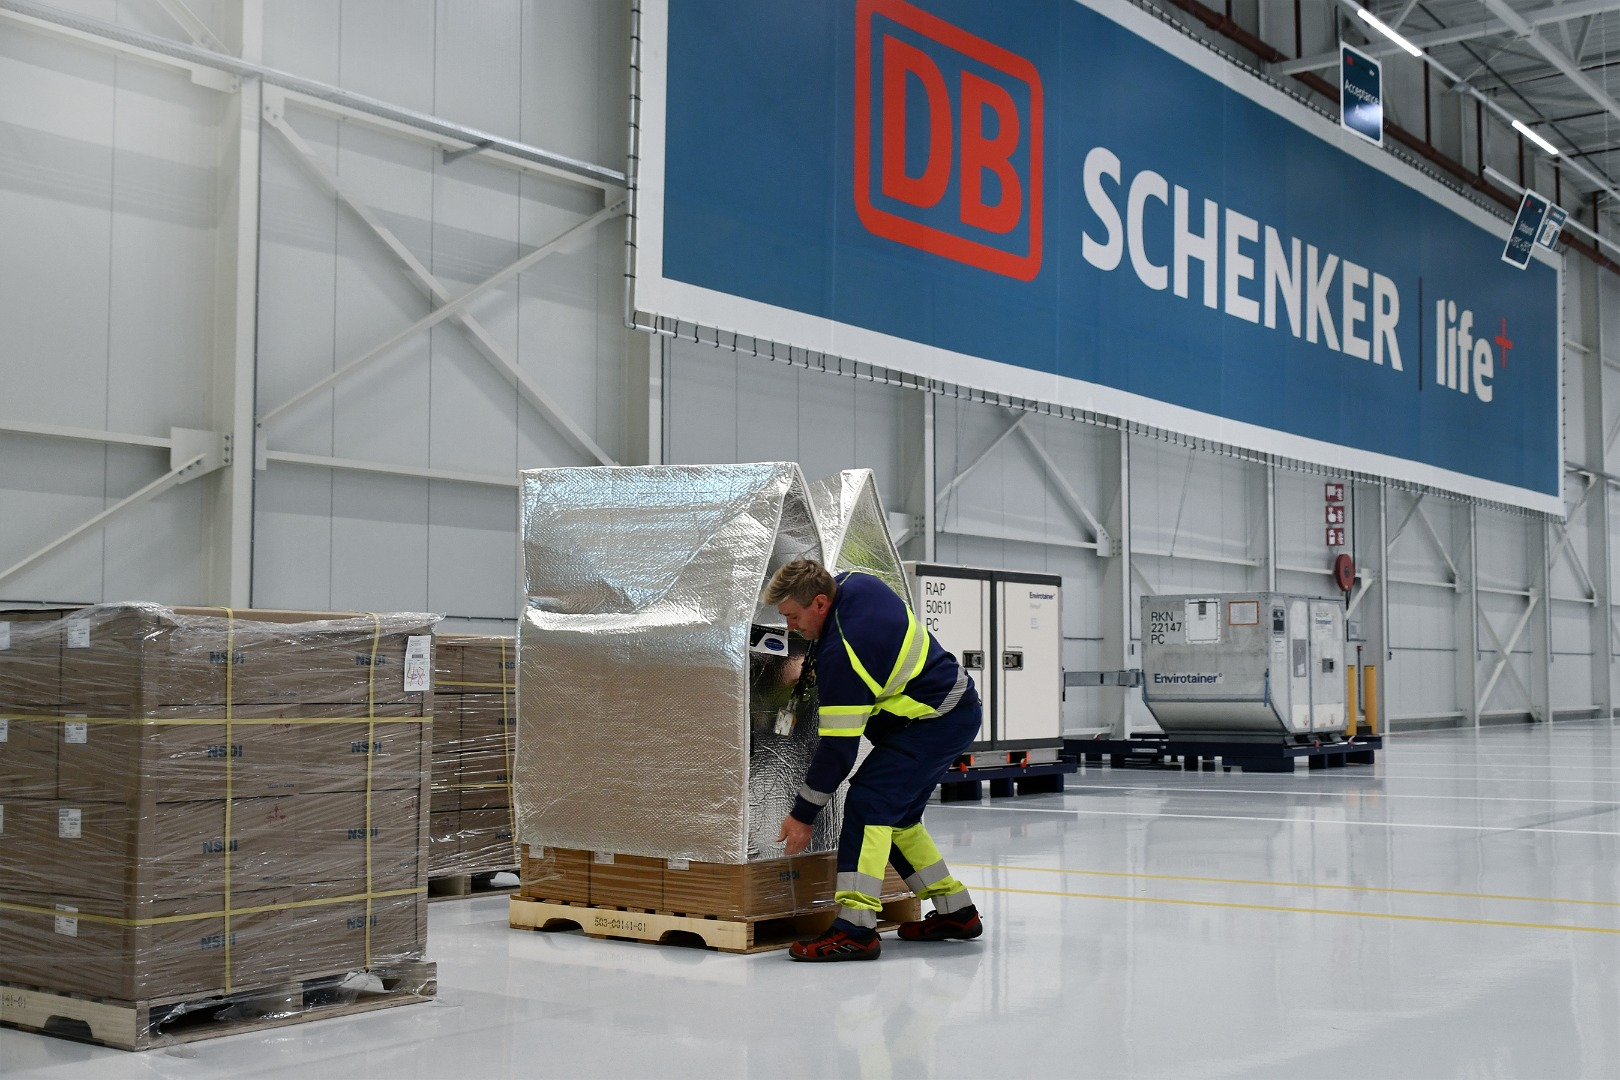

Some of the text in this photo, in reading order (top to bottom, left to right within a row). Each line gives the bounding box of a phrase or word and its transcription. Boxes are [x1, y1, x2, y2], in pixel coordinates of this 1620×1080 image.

[882, 33, 1022, 234] DB
[1082, 146, 1403, 371] SCHENKER
[926, 581, 946, 596] RAP
[926, 600, 951, 614] 50611
[1151, 611, 1174, 622] RKN
[926, 617, 939, 631] PC
[1151, 622, 1182, 633] 22147
[1151, 633, 1165, 645] PC
